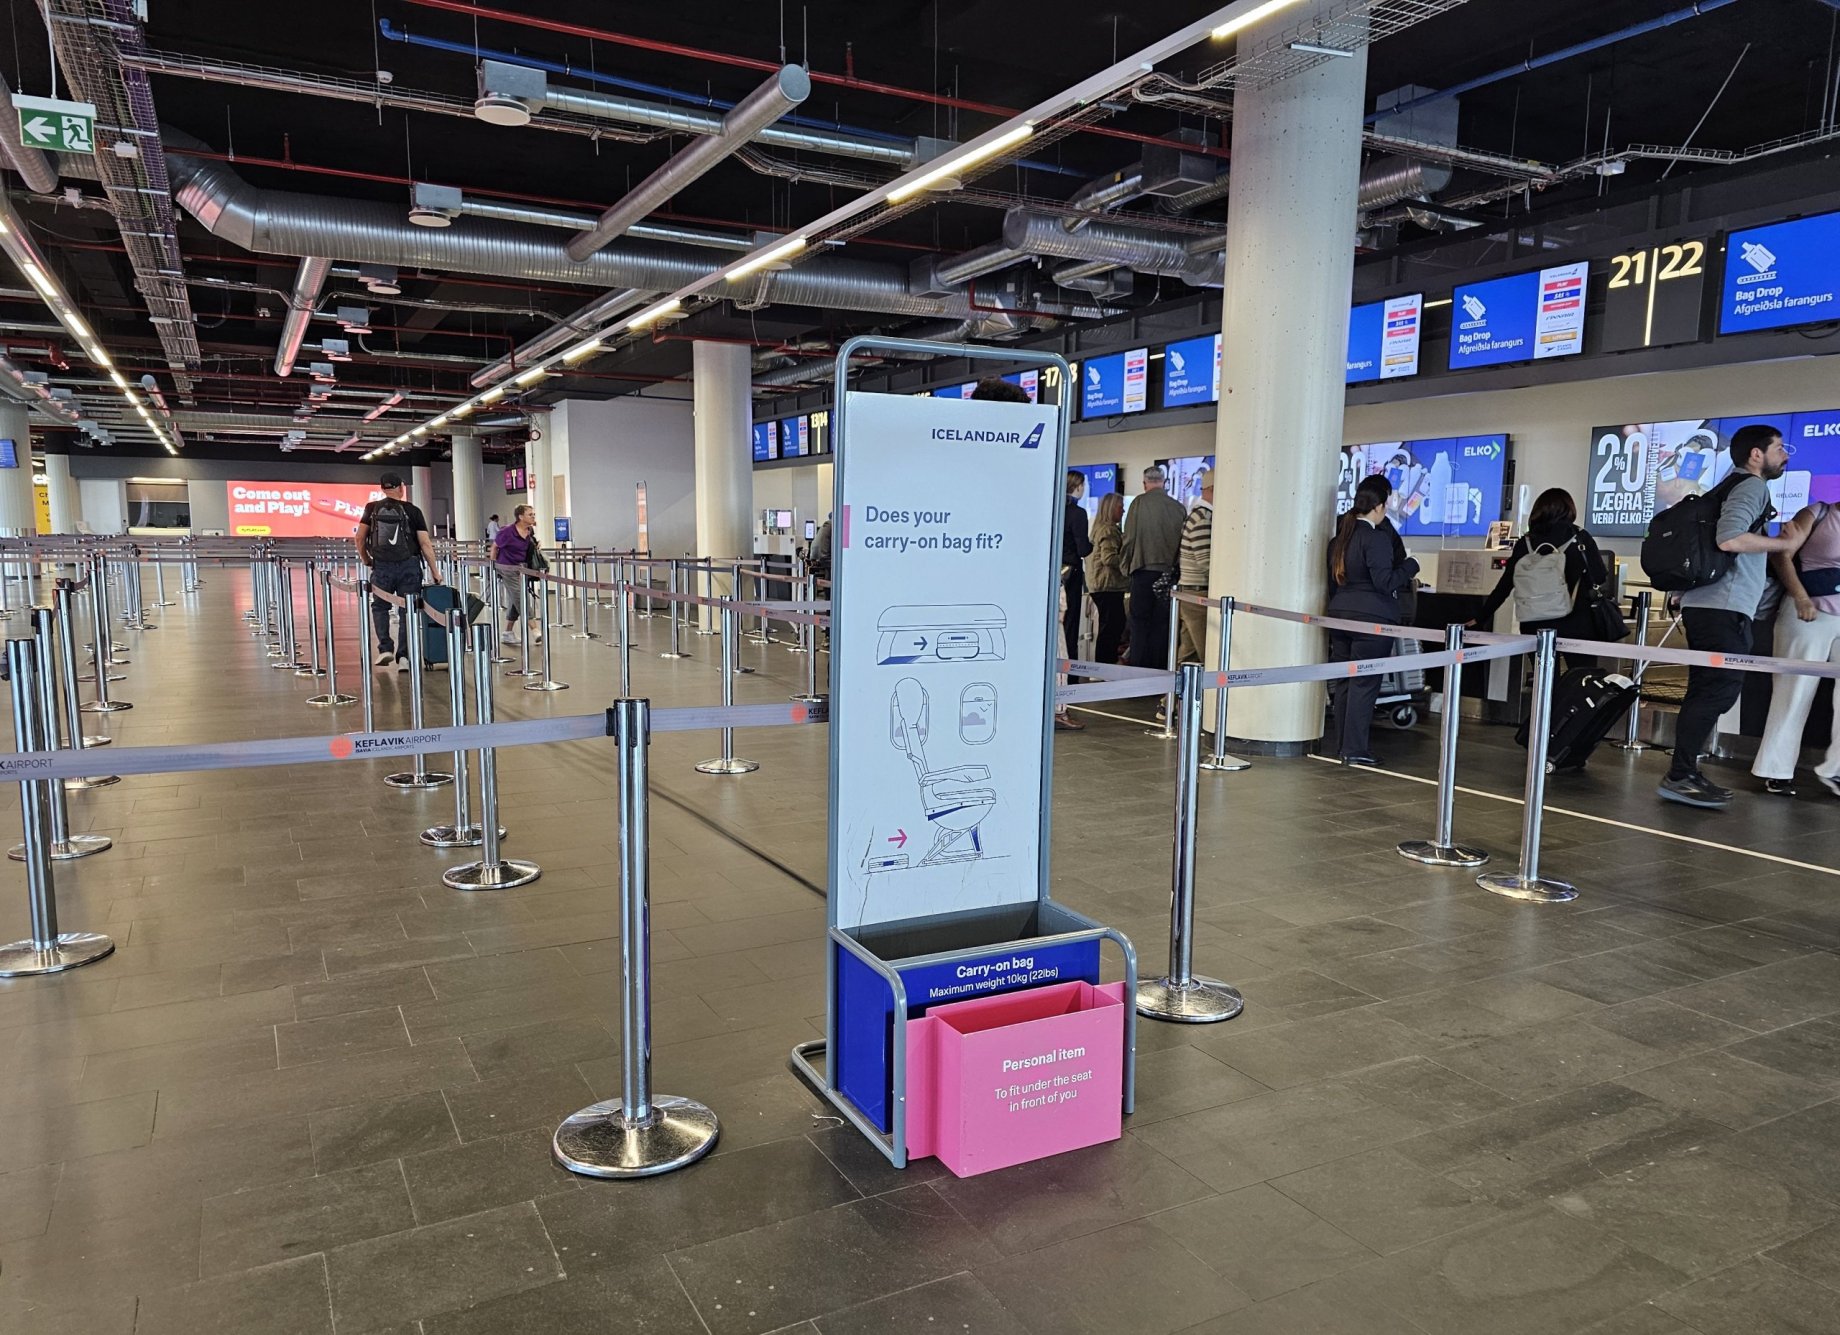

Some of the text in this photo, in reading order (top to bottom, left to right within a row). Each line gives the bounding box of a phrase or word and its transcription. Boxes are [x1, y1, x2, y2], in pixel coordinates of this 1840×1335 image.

[1609, 241, 1704, 289] 21 22
[1734, 292, 1833, 316] Afgreiðsla farangurs
[1735, 286, 1783, 303] Bag Drop
[1459, 331, 1491, 344] Bag Drop
[1491, 338, 1523, 350] farangurs
[1045, 366, 1060, 388] 17
[811, 410, 829, 429] 13 14
[932, 428, 1020, 444] ICELANDAIR
[1464, 445, 1492, 457] ELKO
[233, 486, 311, 501] Come out
[1593, 492, 1643, 512] LÆGRA
[234, 501, 310, 518] and Play!
[865, 505, 950, 528] Does your
[1592, 512, 1614, 525] VERÐ
[1620, 512, 1642, 525] ELKO
[864, 532, 1003, 553] carry-on bag fit?
[355, 734, 442, 749] KEFLAVIK AIRPORT
[6, 758, 54, 770] AIRPORT
[956, 956, 1034, 979] Carry-on bag
[929, 967, 1059, 998] Maximum weight 10kg (22lbs)
[1003, 1046, 1086, 1072] Personal item
[995, 1070, 1092, 1100] To fit under the seat
[1009, 1089, 1077, 1112] in front of you
